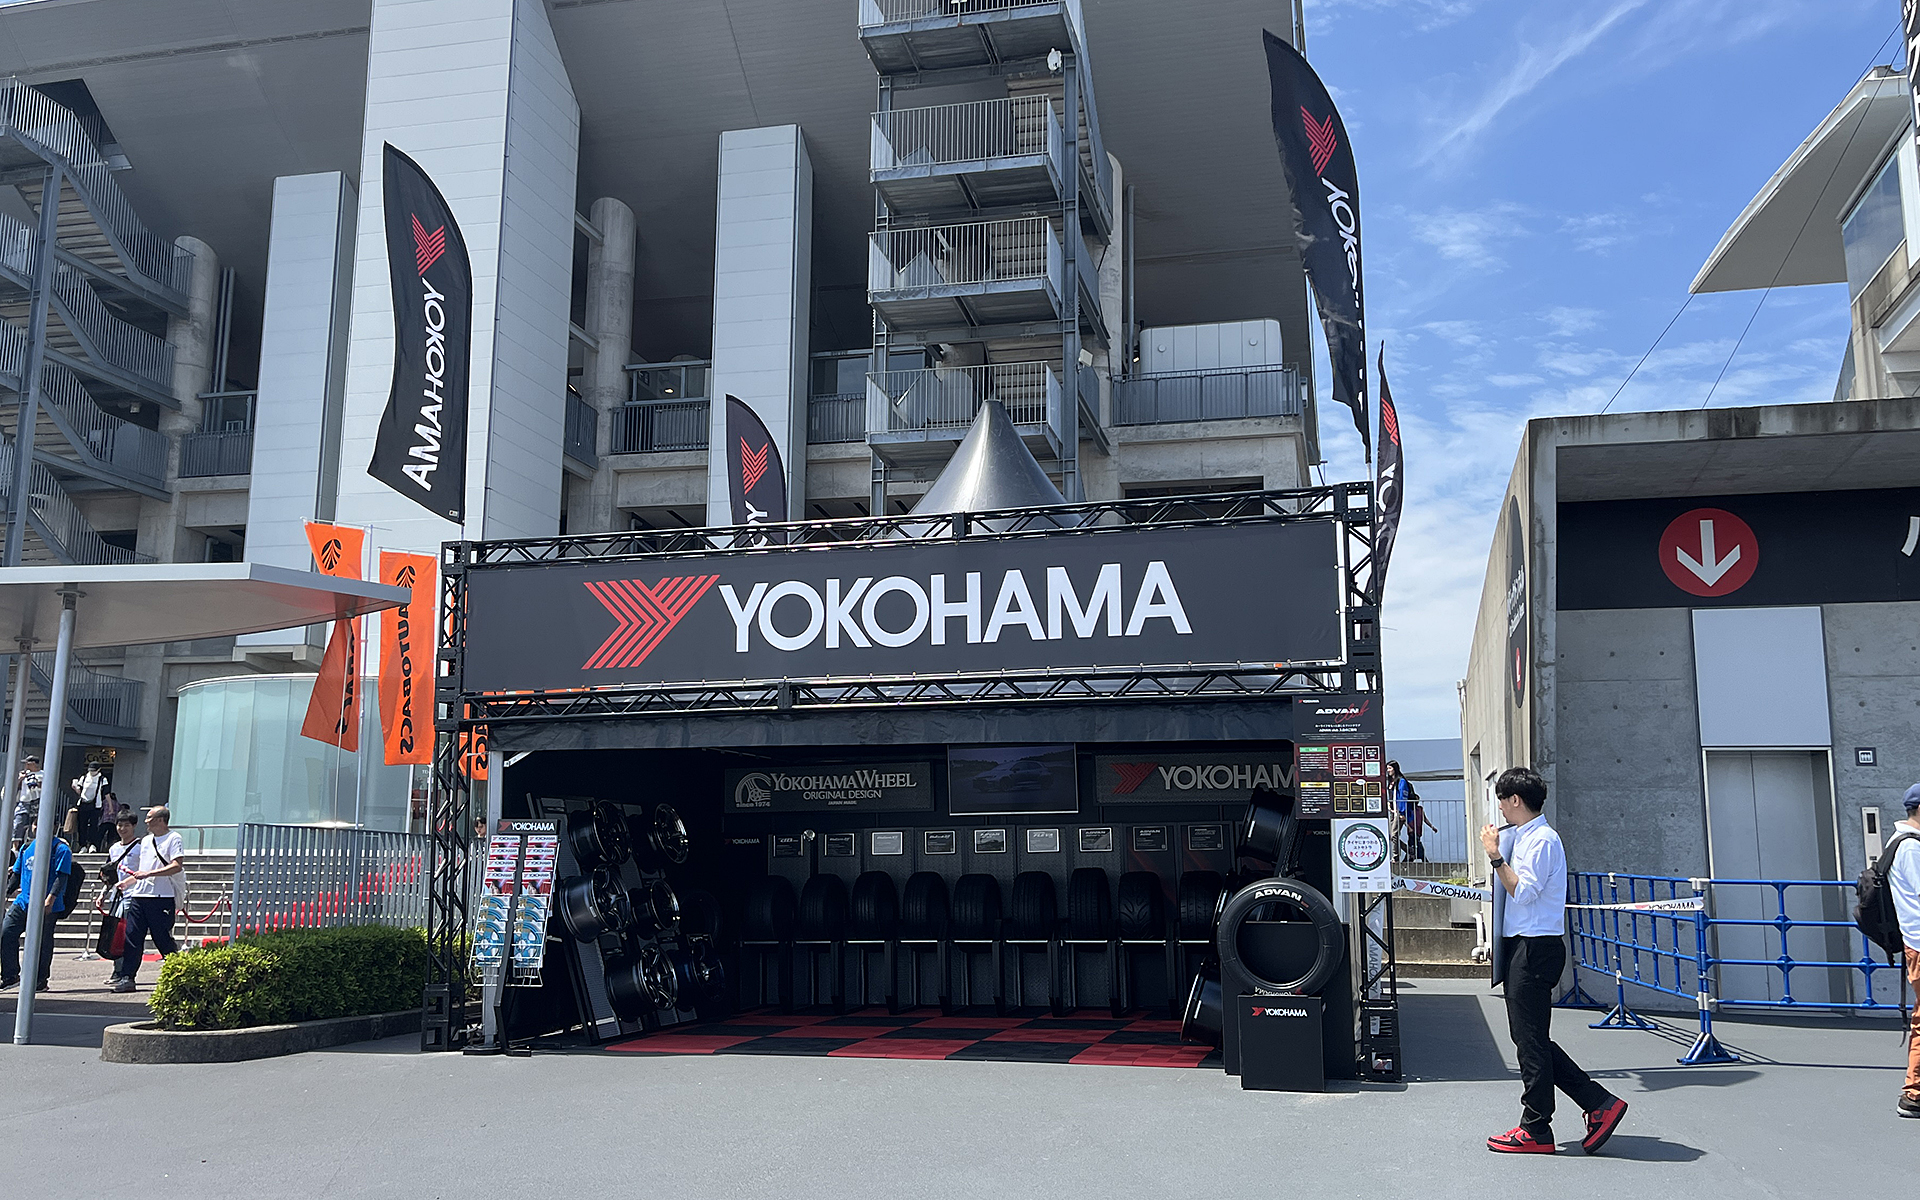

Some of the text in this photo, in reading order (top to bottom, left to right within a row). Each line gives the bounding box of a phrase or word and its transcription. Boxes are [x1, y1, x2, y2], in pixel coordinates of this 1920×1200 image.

[718, 560, 1192, 653] YOKOHAMA
[770, 769, 917, 792] YOKOHAMA WHEEL
[1158, 763, 1296, 790] YOKOHAM
[803, 788, 882, 800] ORIGINAL DESIGN
[511, 822, 555, 831] YOKOHAMA
[1254, 888, 1303, 902] ADVAN
[1429, 884, 1482, 901] YOKOHAMA
[1264, 1007, 1308, 1017] YOKOHAMA
